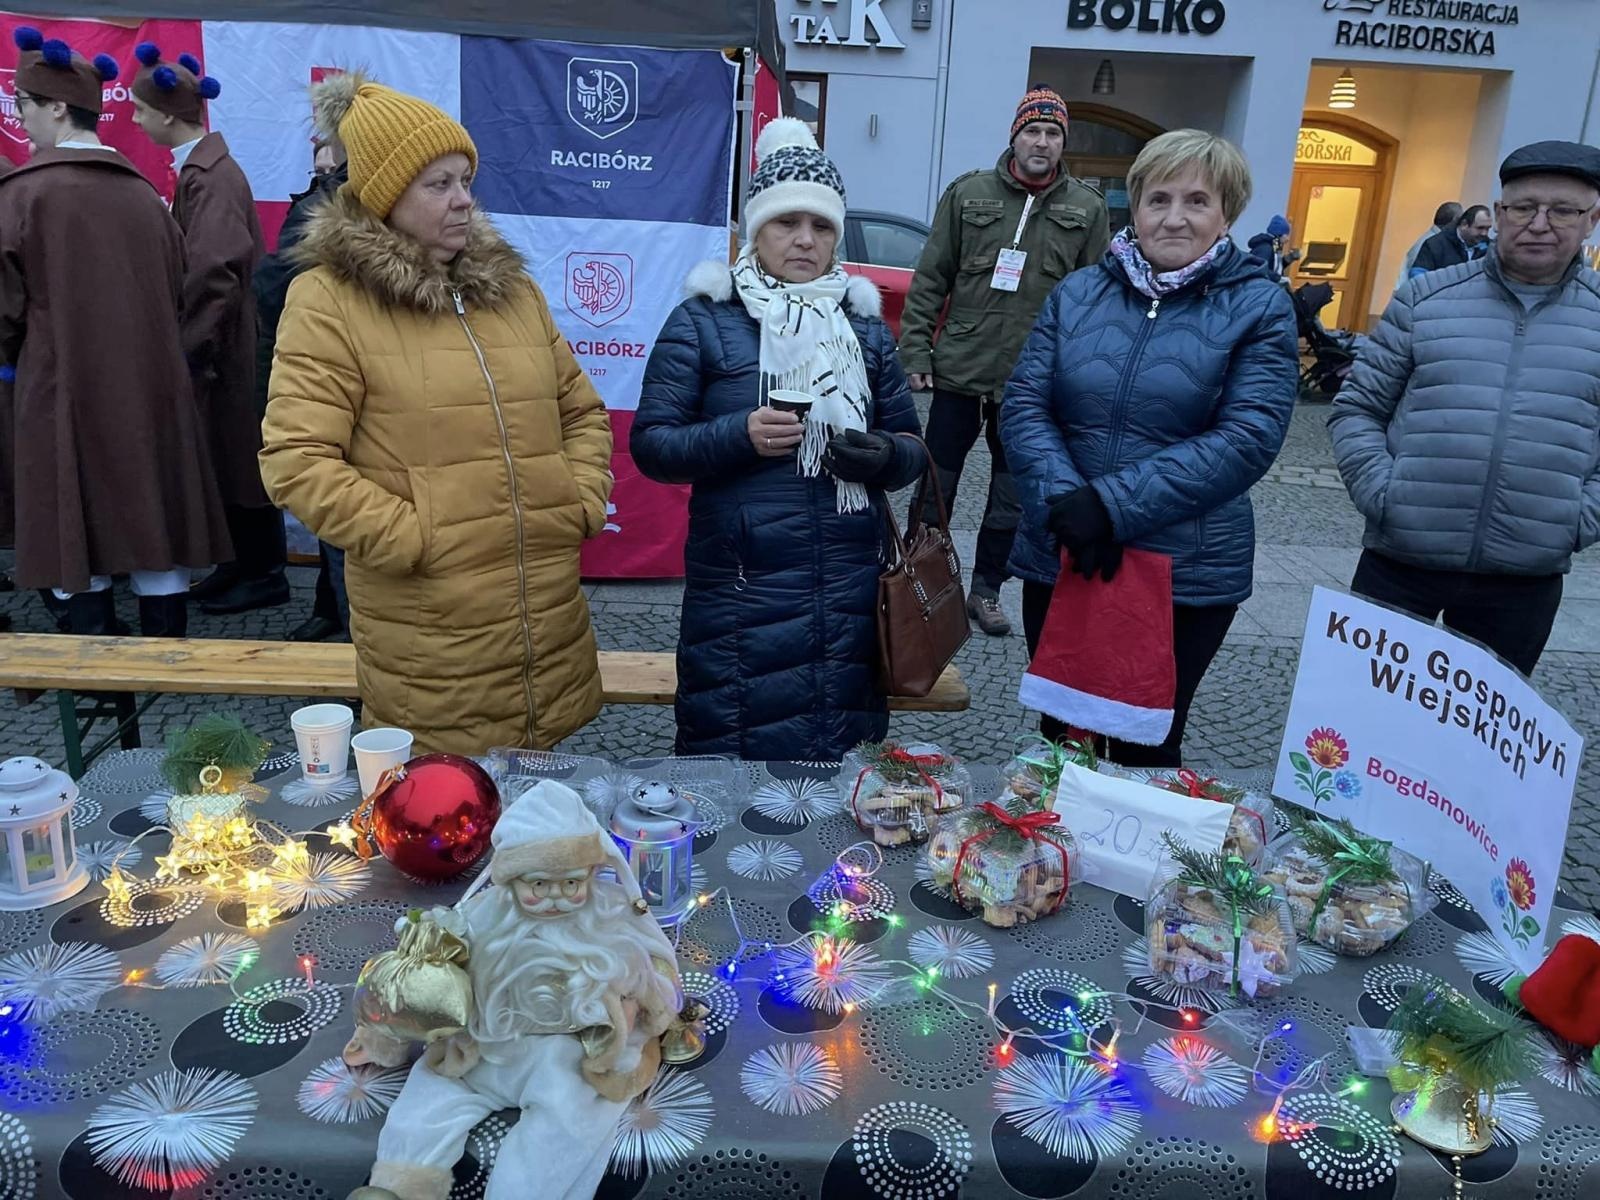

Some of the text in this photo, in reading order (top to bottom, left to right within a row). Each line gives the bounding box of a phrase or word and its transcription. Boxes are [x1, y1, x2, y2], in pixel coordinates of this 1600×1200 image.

[1067, 0, 1225, 34] BOLKO
[1388, 0, 1519, 24] RESTAURACJA
[1335, 20, 1496, 55] RACIBORSKA
[99, 113, 115, 122] 217
[551, 149, 653, 171] RACIBÓRZ
[1296, 143, 1352, 161] BORSKA
[592, 180, 611, 189] 1217
[589, 368, 607, 376] 1217
[1326, 611, 1567, 778] Koło Gospodyń
[1370, 658, 1527, 781] Wiejskich
[1366, 757, 1499, 862] Bogdanowice
[1080, 809, 1142, 854] 20
